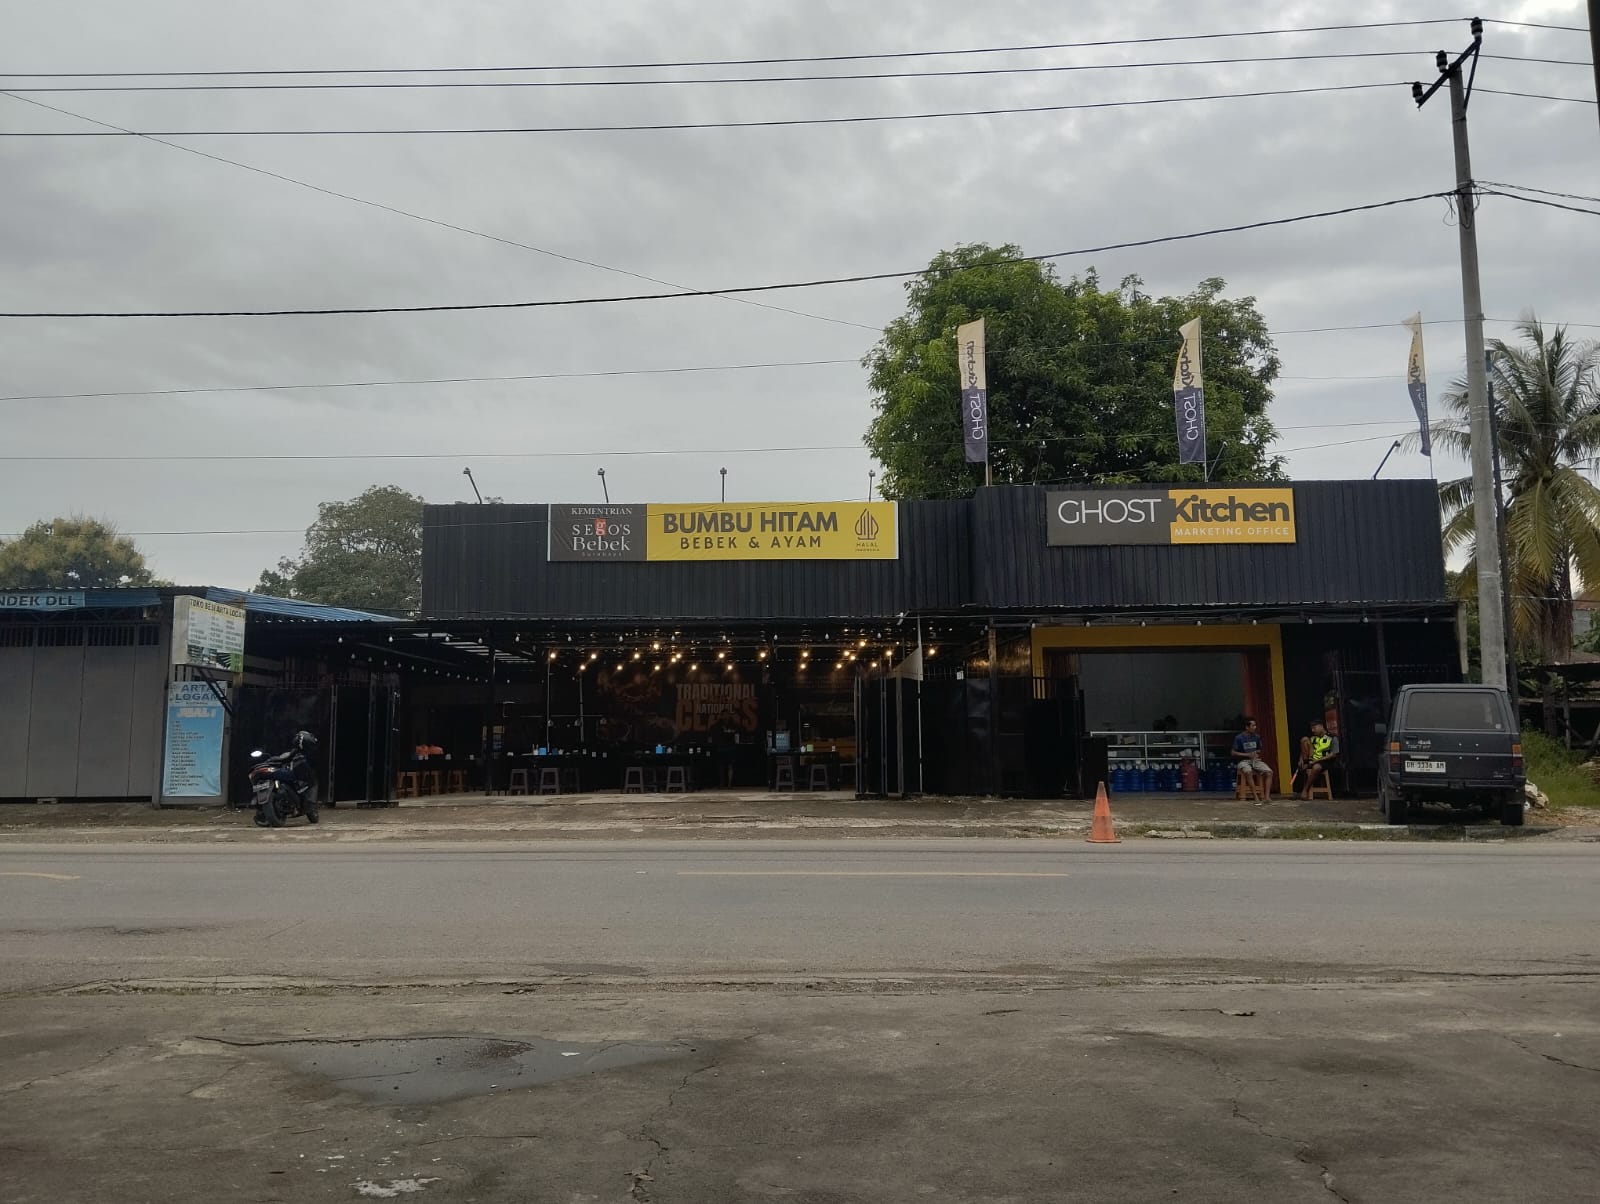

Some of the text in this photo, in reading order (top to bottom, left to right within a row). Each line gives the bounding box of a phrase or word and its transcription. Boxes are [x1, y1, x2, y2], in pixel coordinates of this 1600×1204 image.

[571, 507, 632, 515] KEMENTRIAN
[1057, 494, 1291, 524] GHOST Kitchen
[663, 511, 838, 534] BUMBU HITAM
[1174, 527, 1290, 536] MARKETING OFFICE
[573, 535, 631, 551] Bebek
[680, 535, 822, 550] BEBEK & AYAM
[45, 595, 77, 606] DLL
[675, 683, 756, 700] TRADITIONAL
